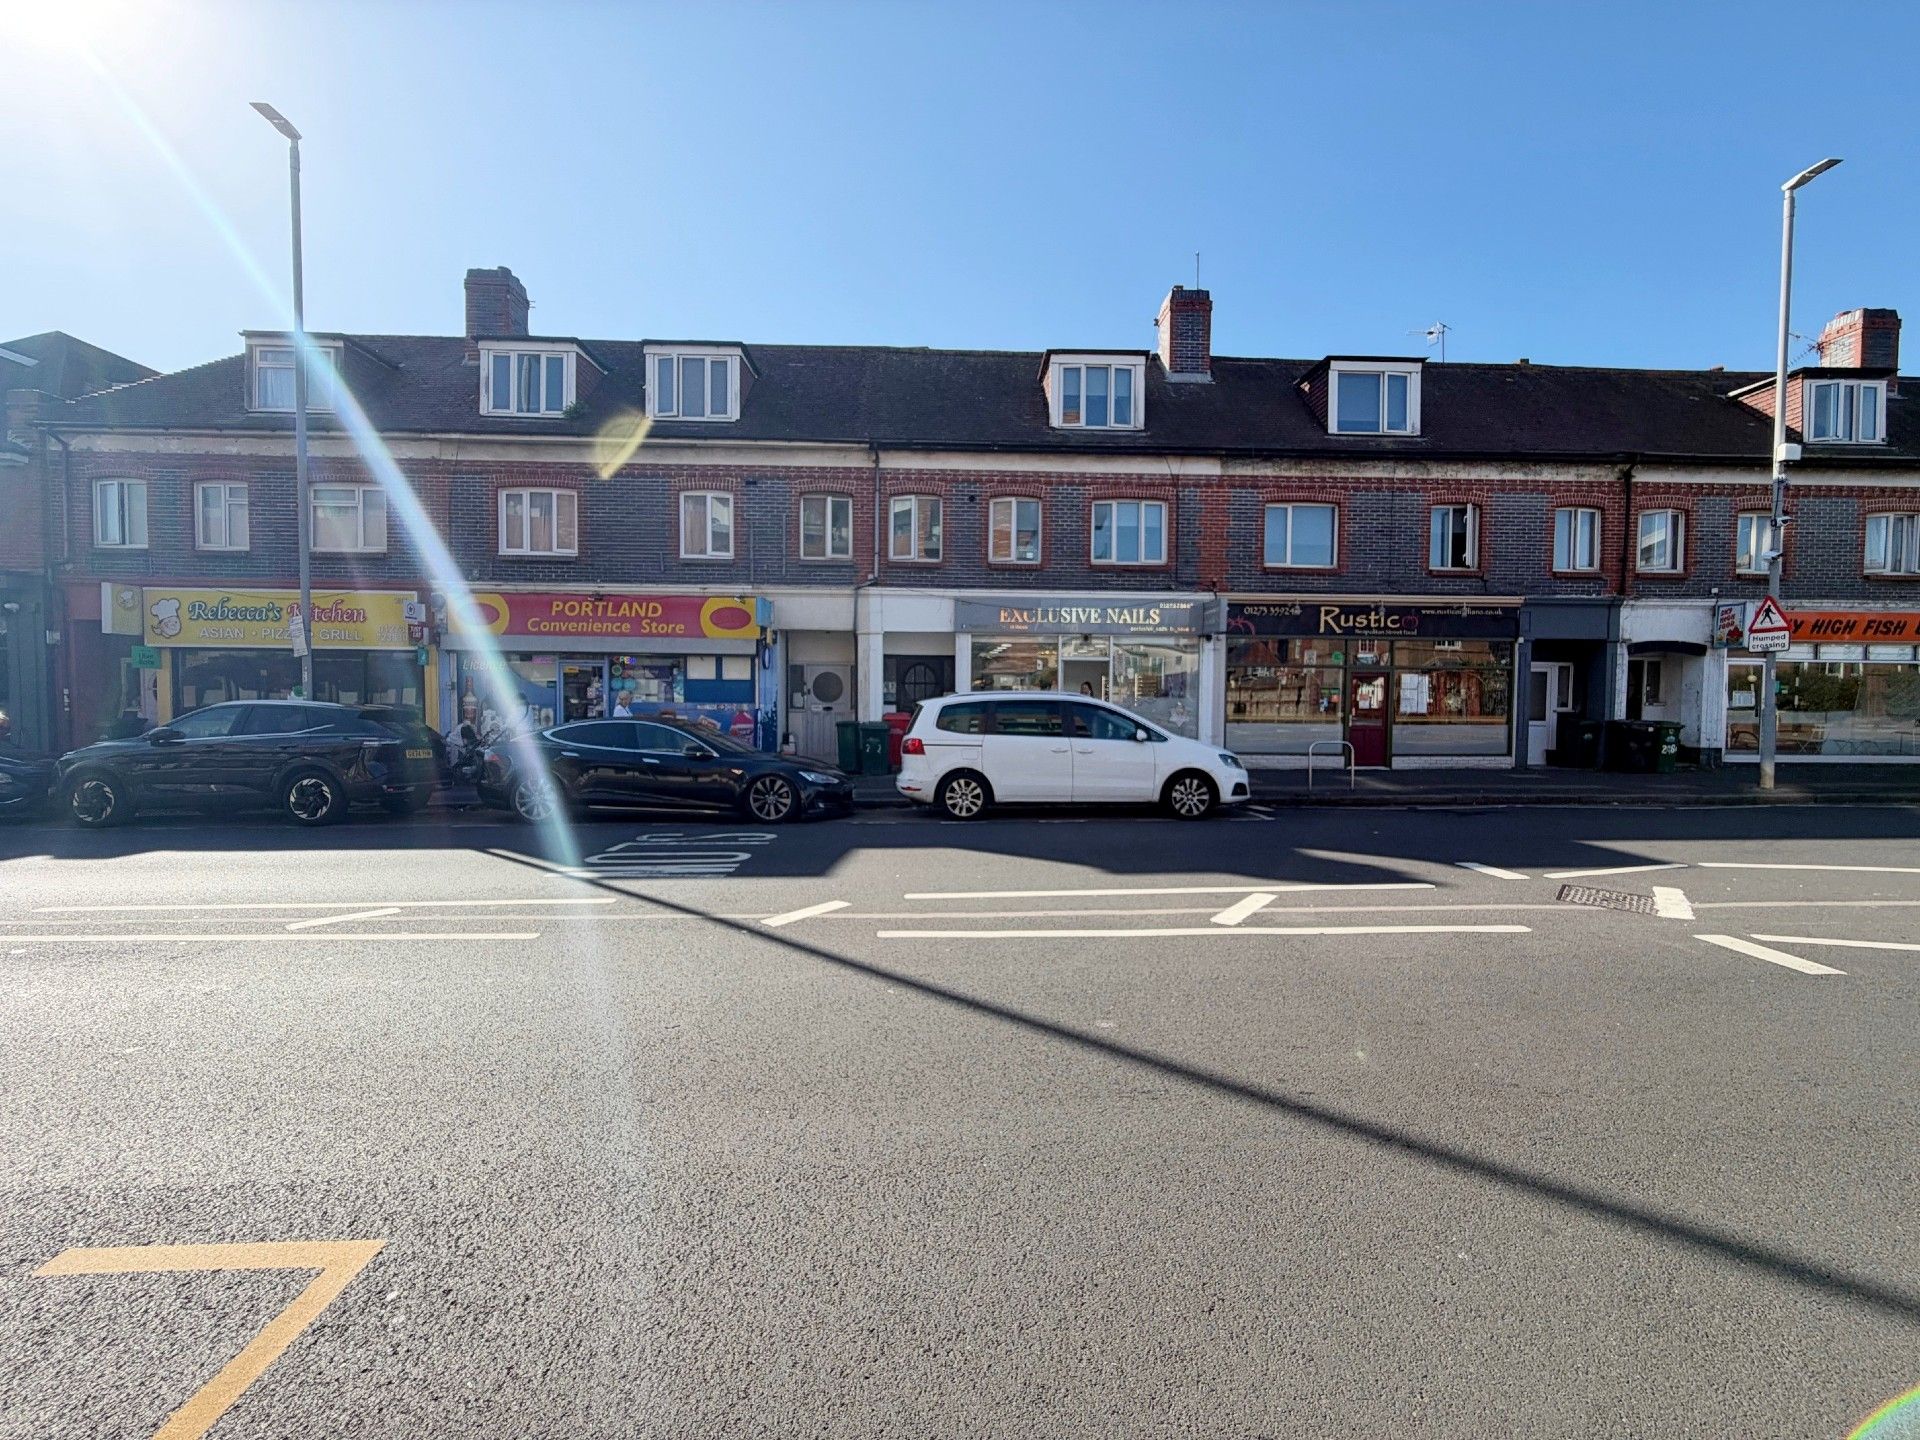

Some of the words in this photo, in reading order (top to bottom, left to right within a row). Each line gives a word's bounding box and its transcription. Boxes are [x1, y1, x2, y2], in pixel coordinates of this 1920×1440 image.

[188, 597, 282, 621] Rebecca's
[287, 600, 366, 623] Ktchen
[551, 601, 662, 618] PORTLAND
[1000, 607, 1101, 624] EXCLUSIVE
[1106, 607, 1160, 625] NAILS
[1269, 606, 1301, 616] 35924
[200, 627, 244, 640] ASIAN
[261, 627, 292, 641] PIZZ
[319, 629, 363, 641] GRILL
[528, 618, 631, 632] Convenience
[641, 619, 685, 634] Store
[1810, 618, 1857, 635] HIGH
[1862, 619, 1908, 636] FISH
[1751, 642, 1786, 651] crossing
[1752, 634, 1786, 643] Humped
